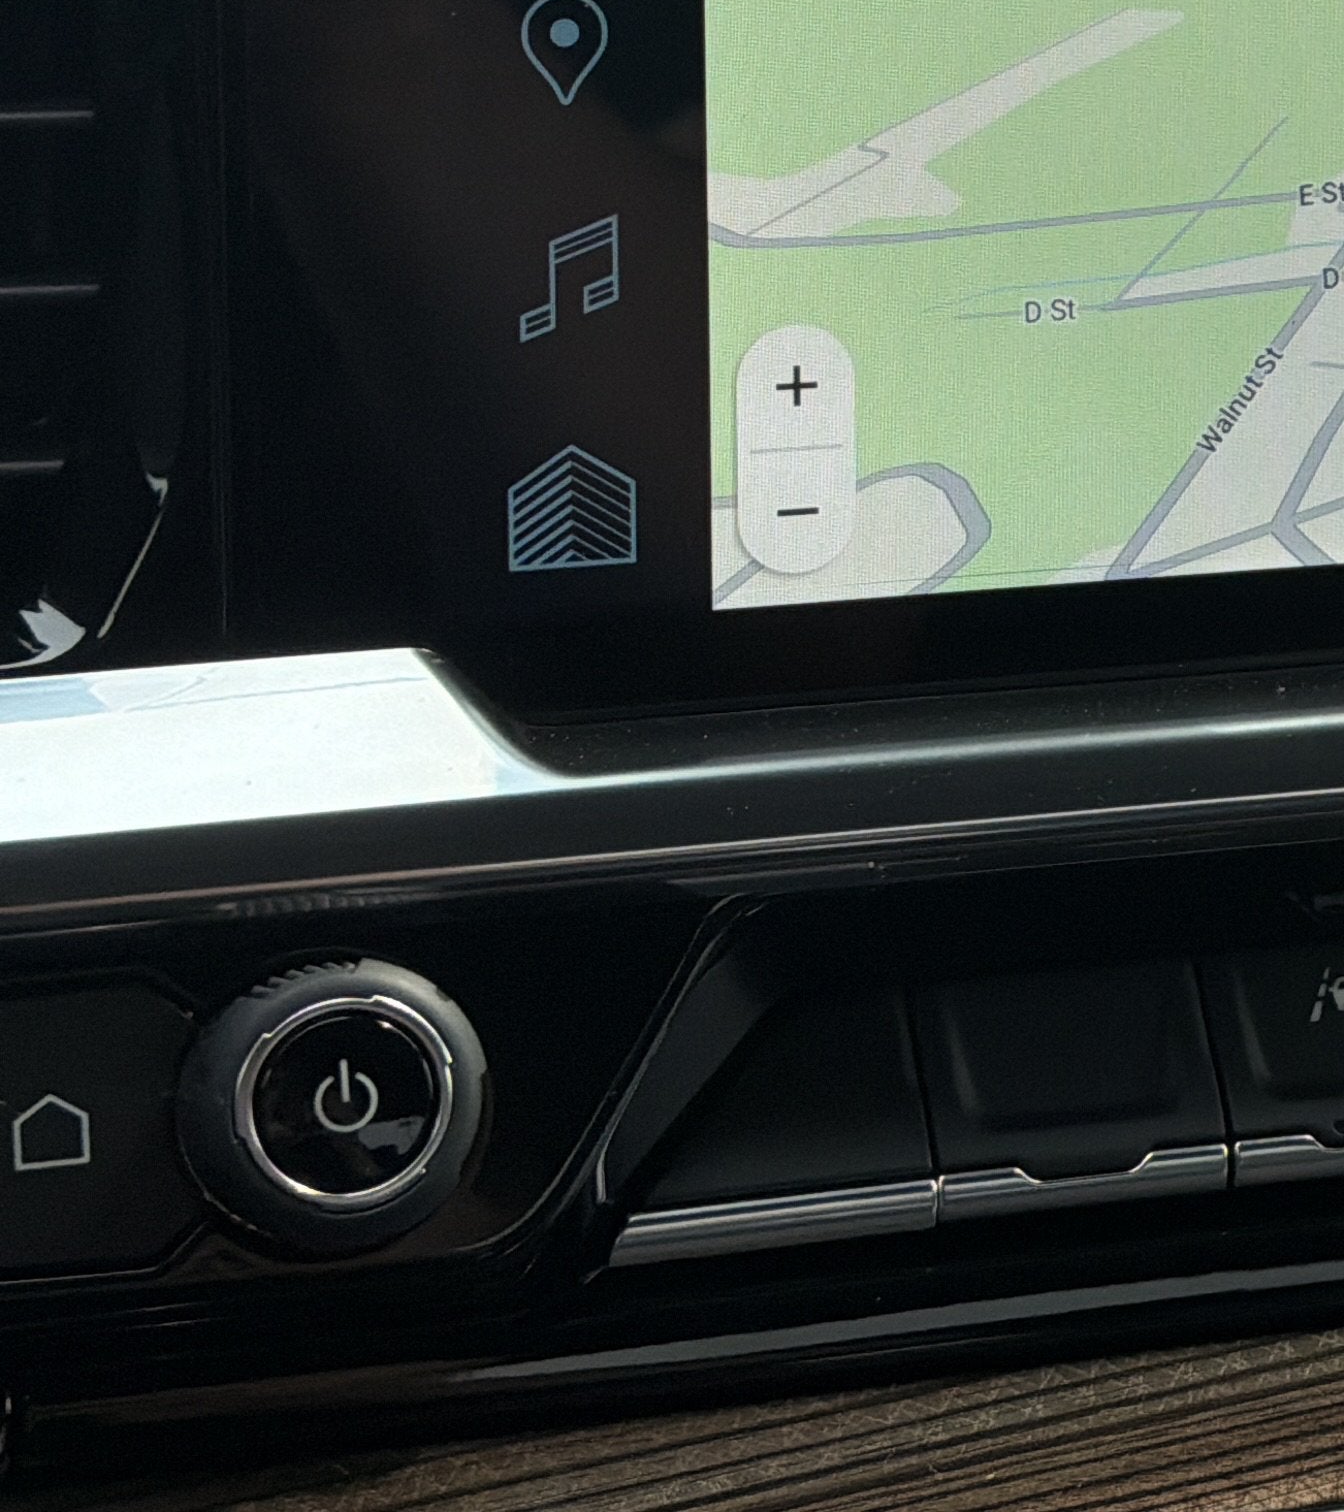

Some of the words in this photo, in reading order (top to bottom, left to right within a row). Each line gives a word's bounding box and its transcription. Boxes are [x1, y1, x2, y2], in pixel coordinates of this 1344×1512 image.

[1300, 184, 1314, 206] E
[1323, 267, 1340, 289] D
[1024, 302, 1041, 324] D
[1050, 299, 1076, 322] St
[1197, 374, 1263, 454] Walnut
[1254, 346, 1285, 379] St
